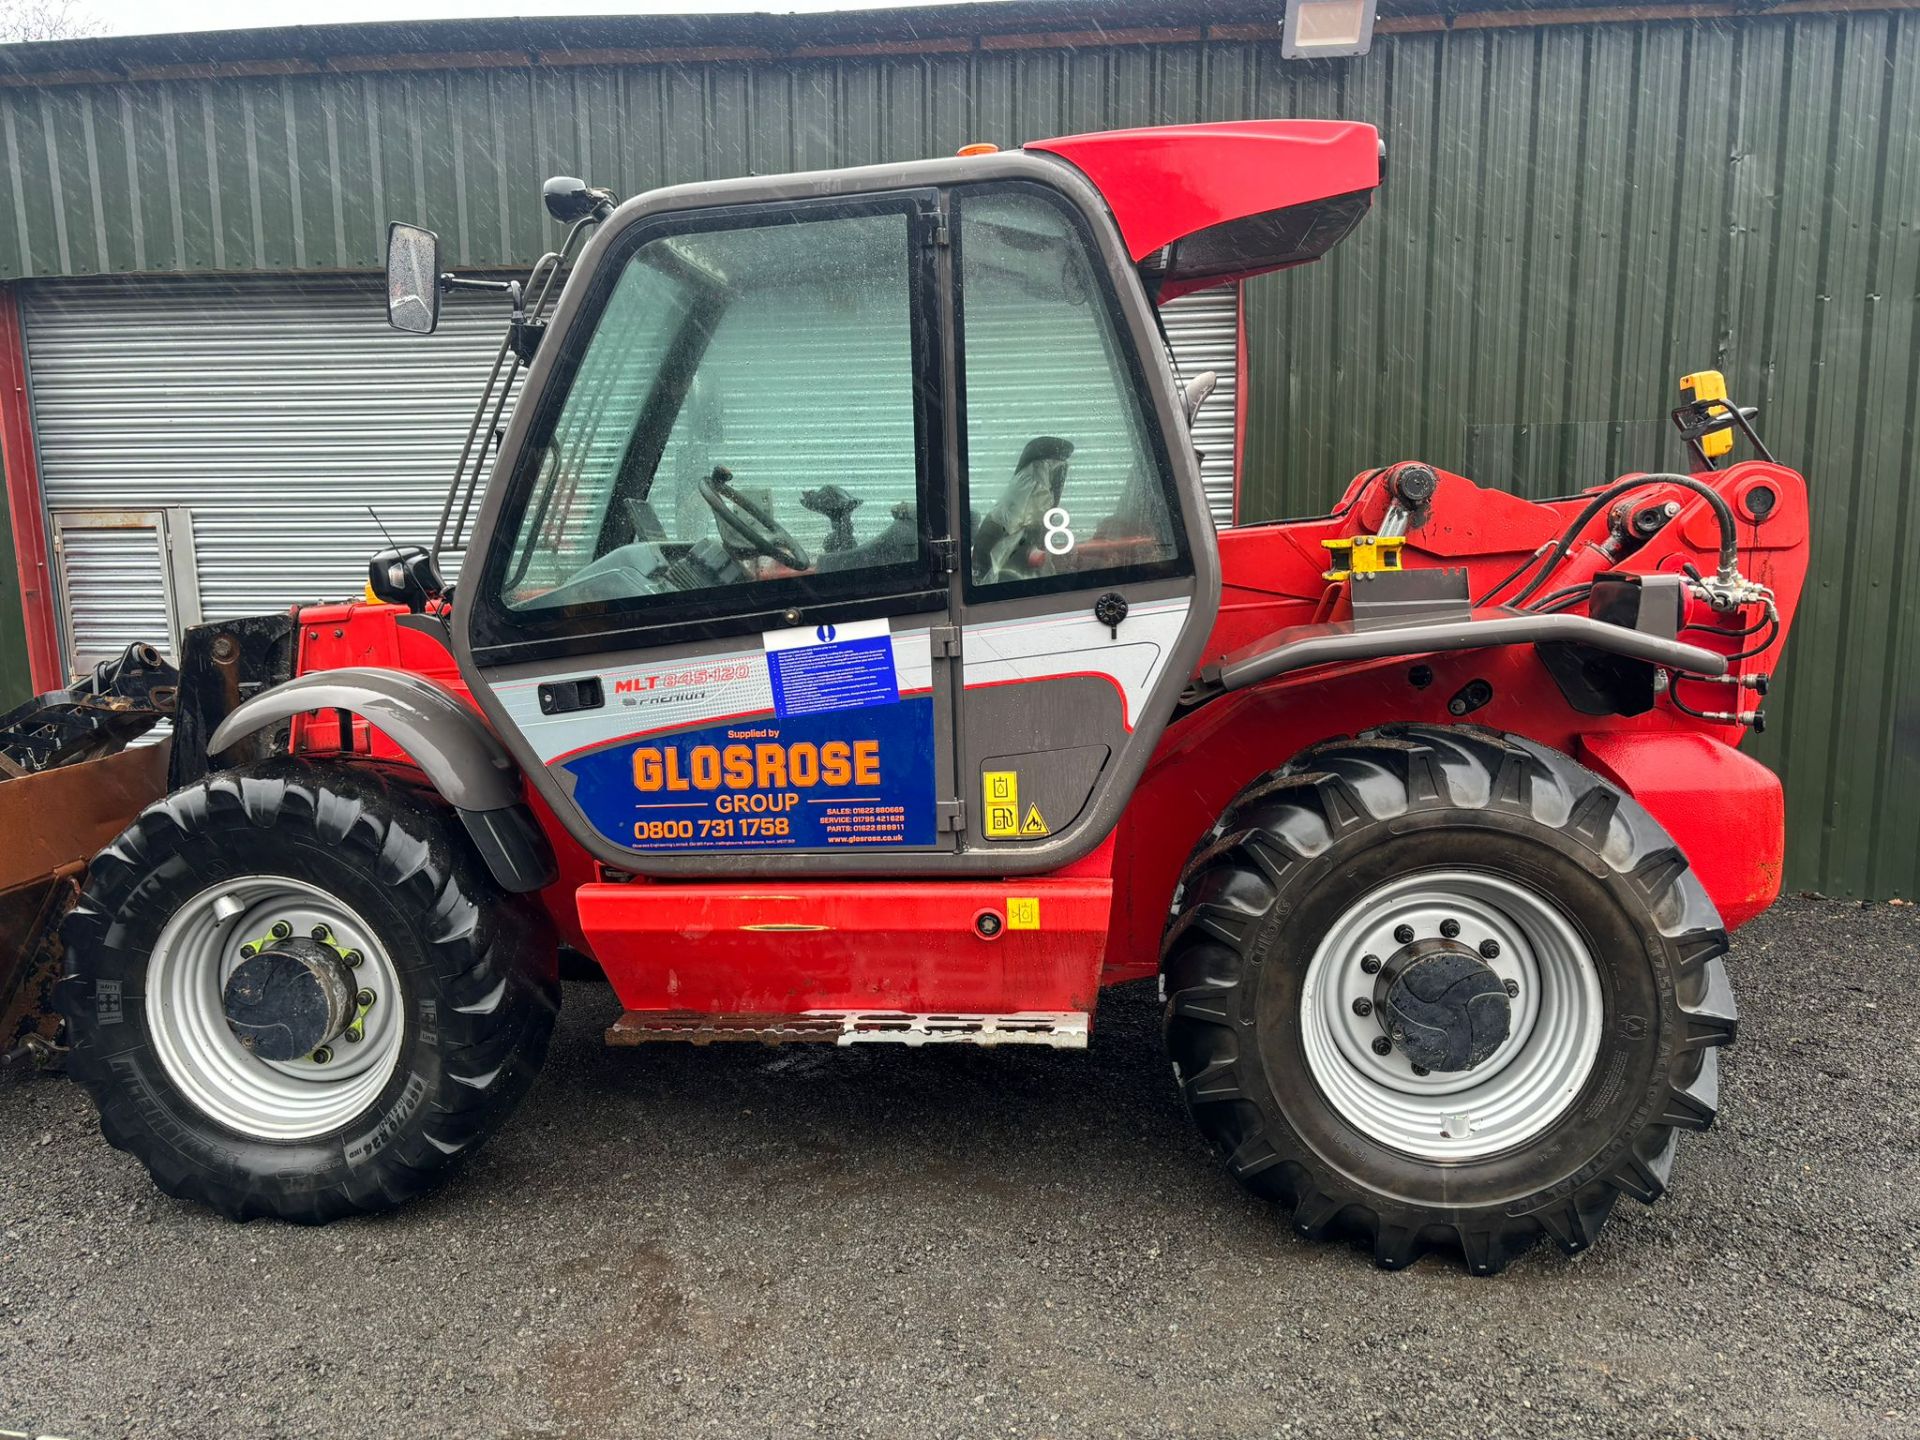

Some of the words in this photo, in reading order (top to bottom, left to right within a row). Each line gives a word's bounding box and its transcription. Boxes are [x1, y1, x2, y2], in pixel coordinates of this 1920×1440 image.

[1043, 507, 1075, 555] 8
[614, 676, 660, 694] MLT
[663, 665, 752, 689] 845-120
[727, 729, 766, 740] Supplied
[768, 728, 781, 739] by
[632, 740, 881, 792] GLOSROSE
[715, 793, 799, 814] GROUP
[853, 807, 874, 815] 01622
[634, 820, 694, 840] 0800
[698, 818, 734, 838] 731
[739, 817, 790, 837] 1758
[820, 816, 852, 824] SERVICE:
[828, 835, 903, 844] www.glosrose.co.uk
